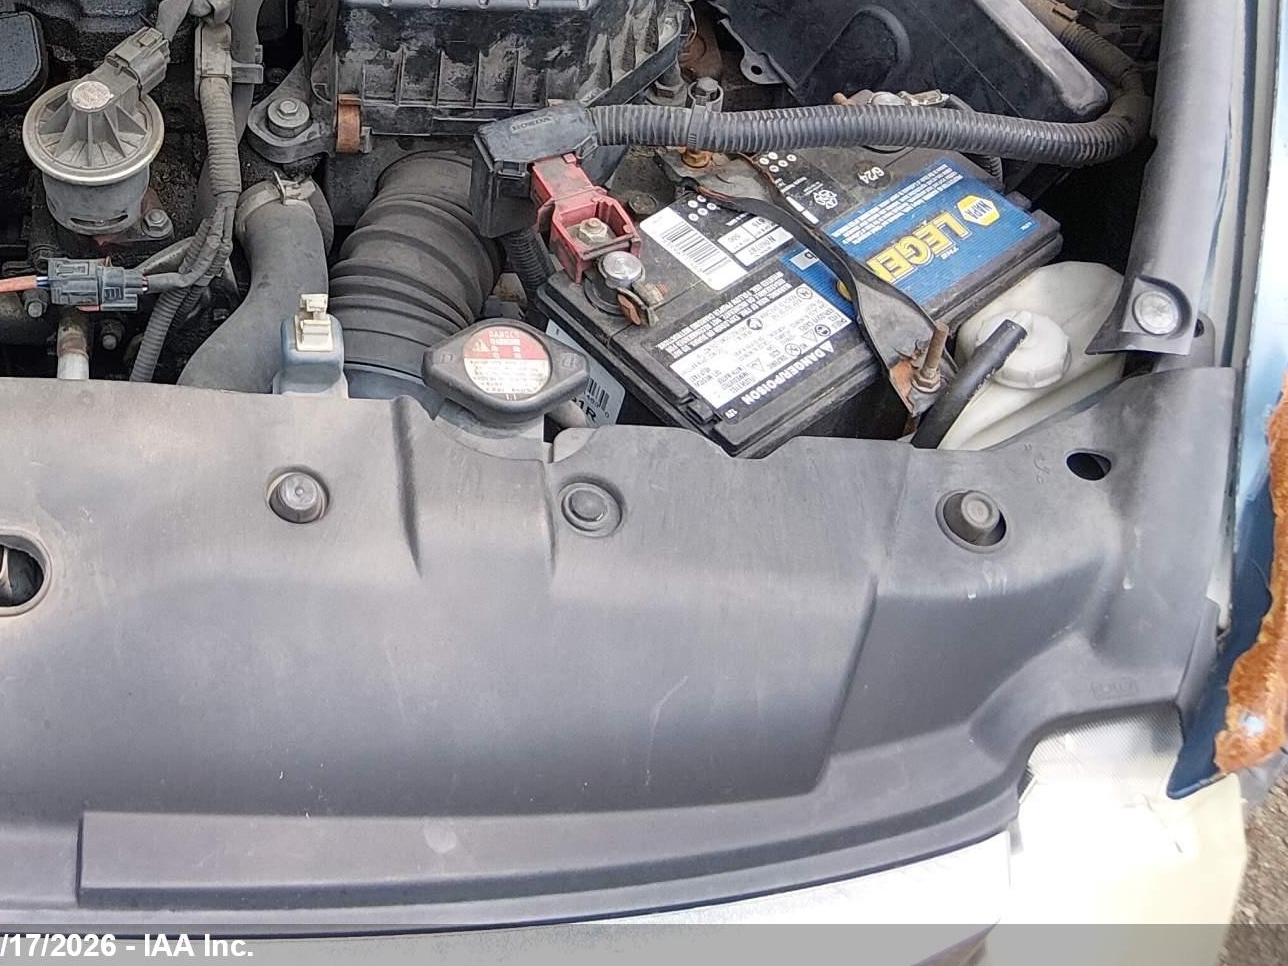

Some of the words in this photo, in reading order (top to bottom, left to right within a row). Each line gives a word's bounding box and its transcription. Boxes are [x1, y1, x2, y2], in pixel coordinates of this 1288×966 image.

[858, 166, 885, 184] 6/24
[964, 200, 992, 220] NAPA
[741, 350, 826, 405] DANGER/POISON
